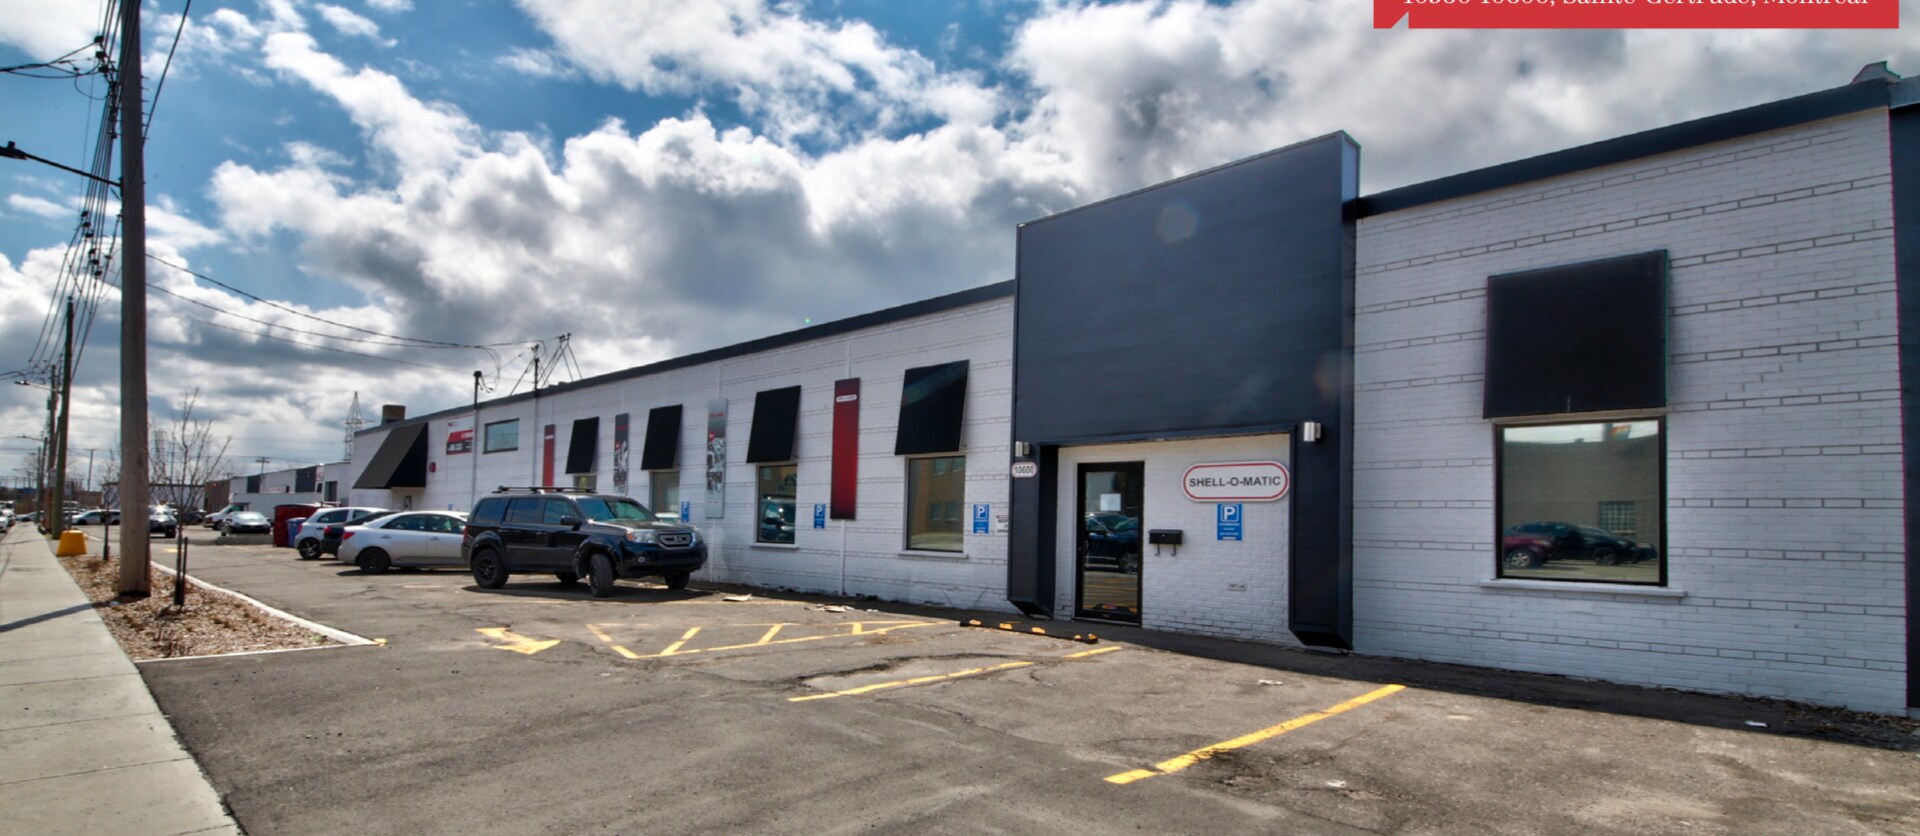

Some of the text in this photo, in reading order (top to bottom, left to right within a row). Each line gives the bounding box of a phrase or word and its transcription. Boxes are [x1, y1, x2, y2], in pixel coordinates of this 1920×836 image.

[1014, 465, 1035, 474] 10600
[1189, 476, 1281, 487] SHELL-O-MATIC
[1223, 506, 1236, 520] P
